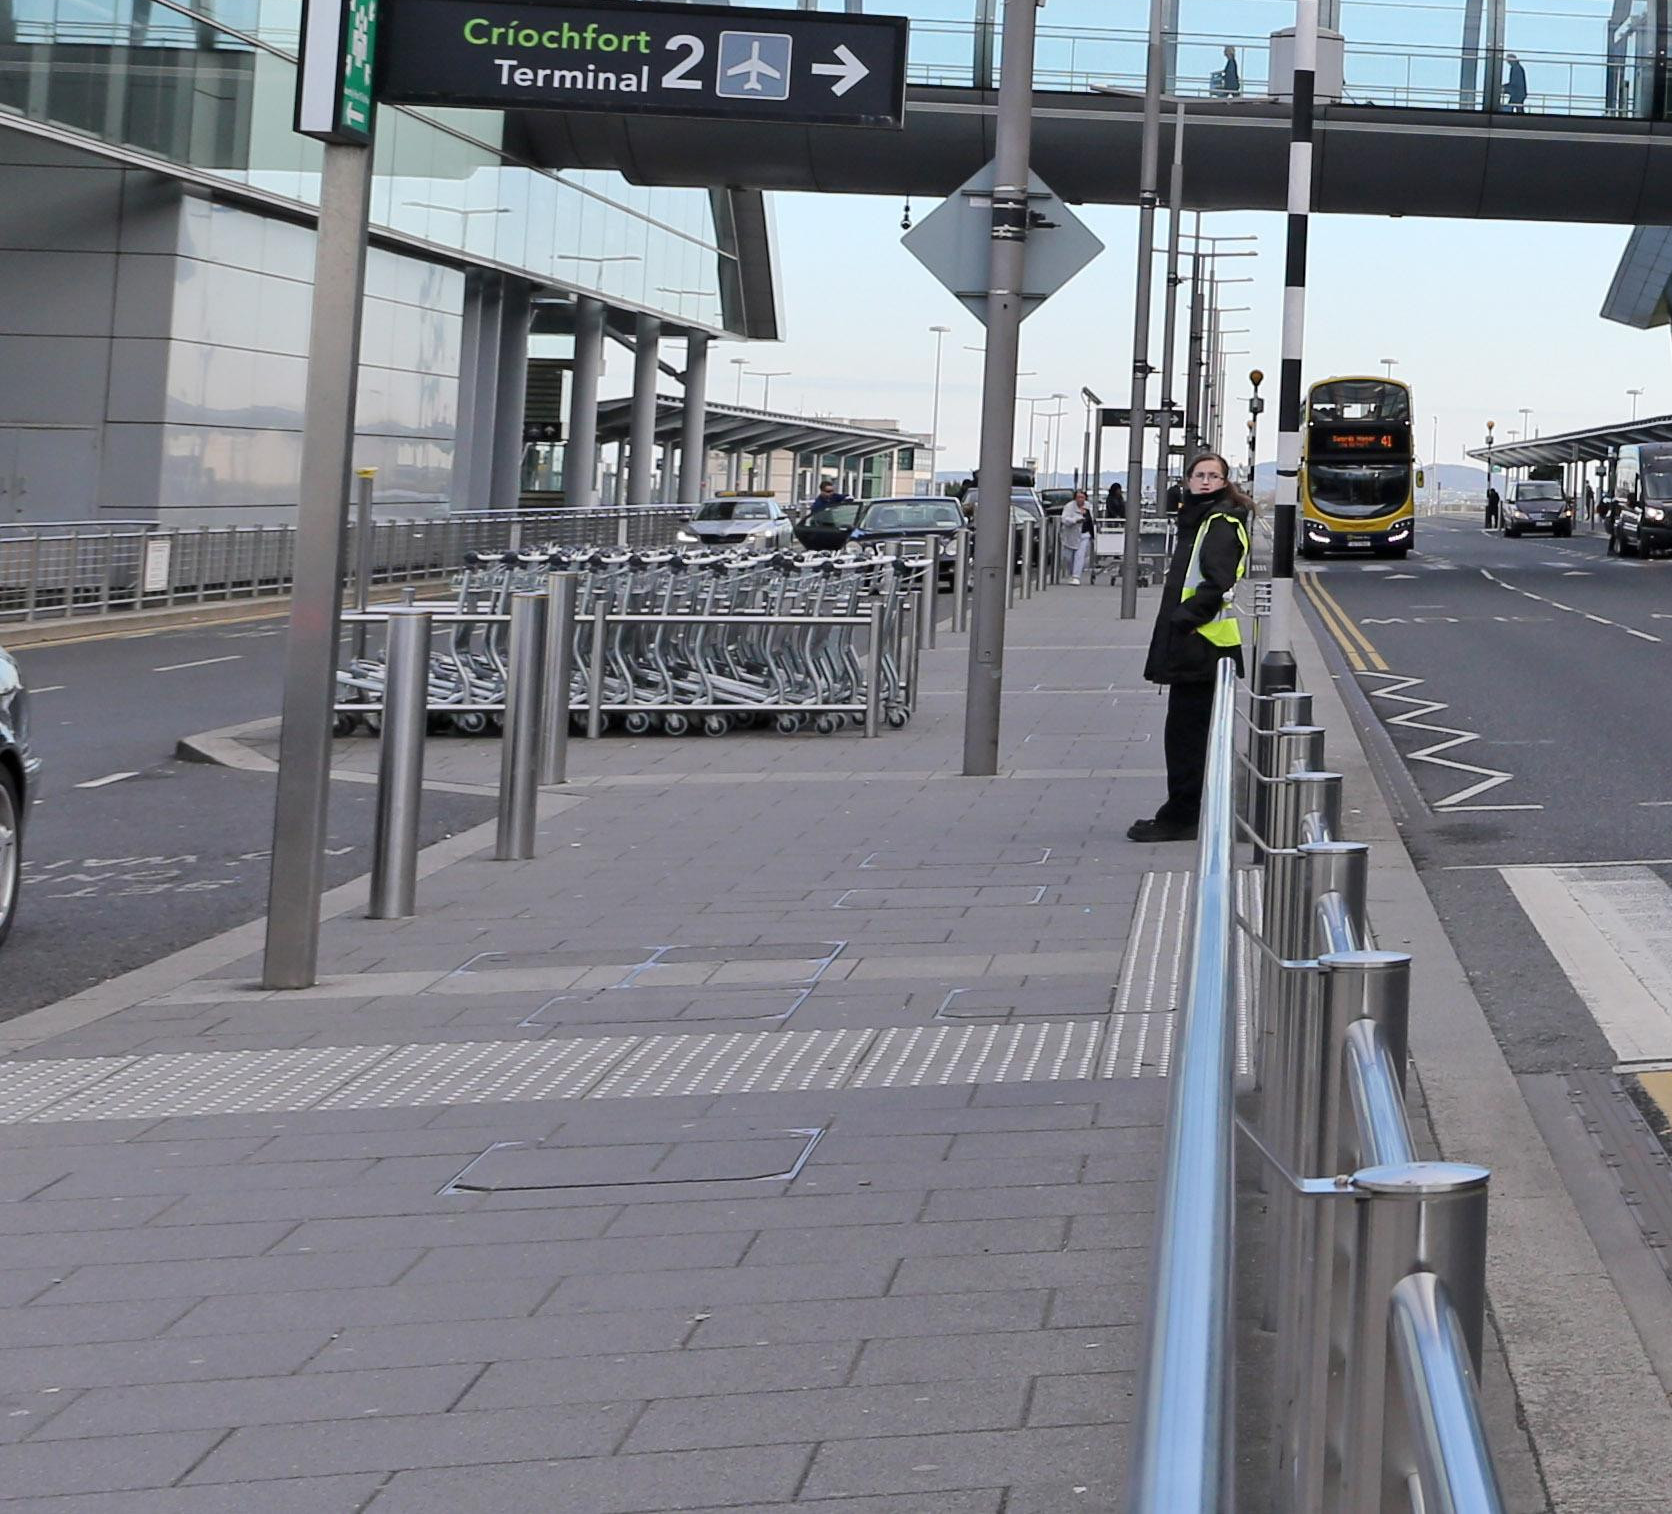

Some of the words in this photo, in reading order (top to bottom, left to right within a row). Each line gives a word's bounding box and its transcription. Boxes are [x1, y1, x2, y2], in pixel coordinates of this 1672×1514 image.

[463, 17, 650, 53] Críochfort
[494, 58, 649, 93] Terminal
[661, 34, 705, 90] 2
